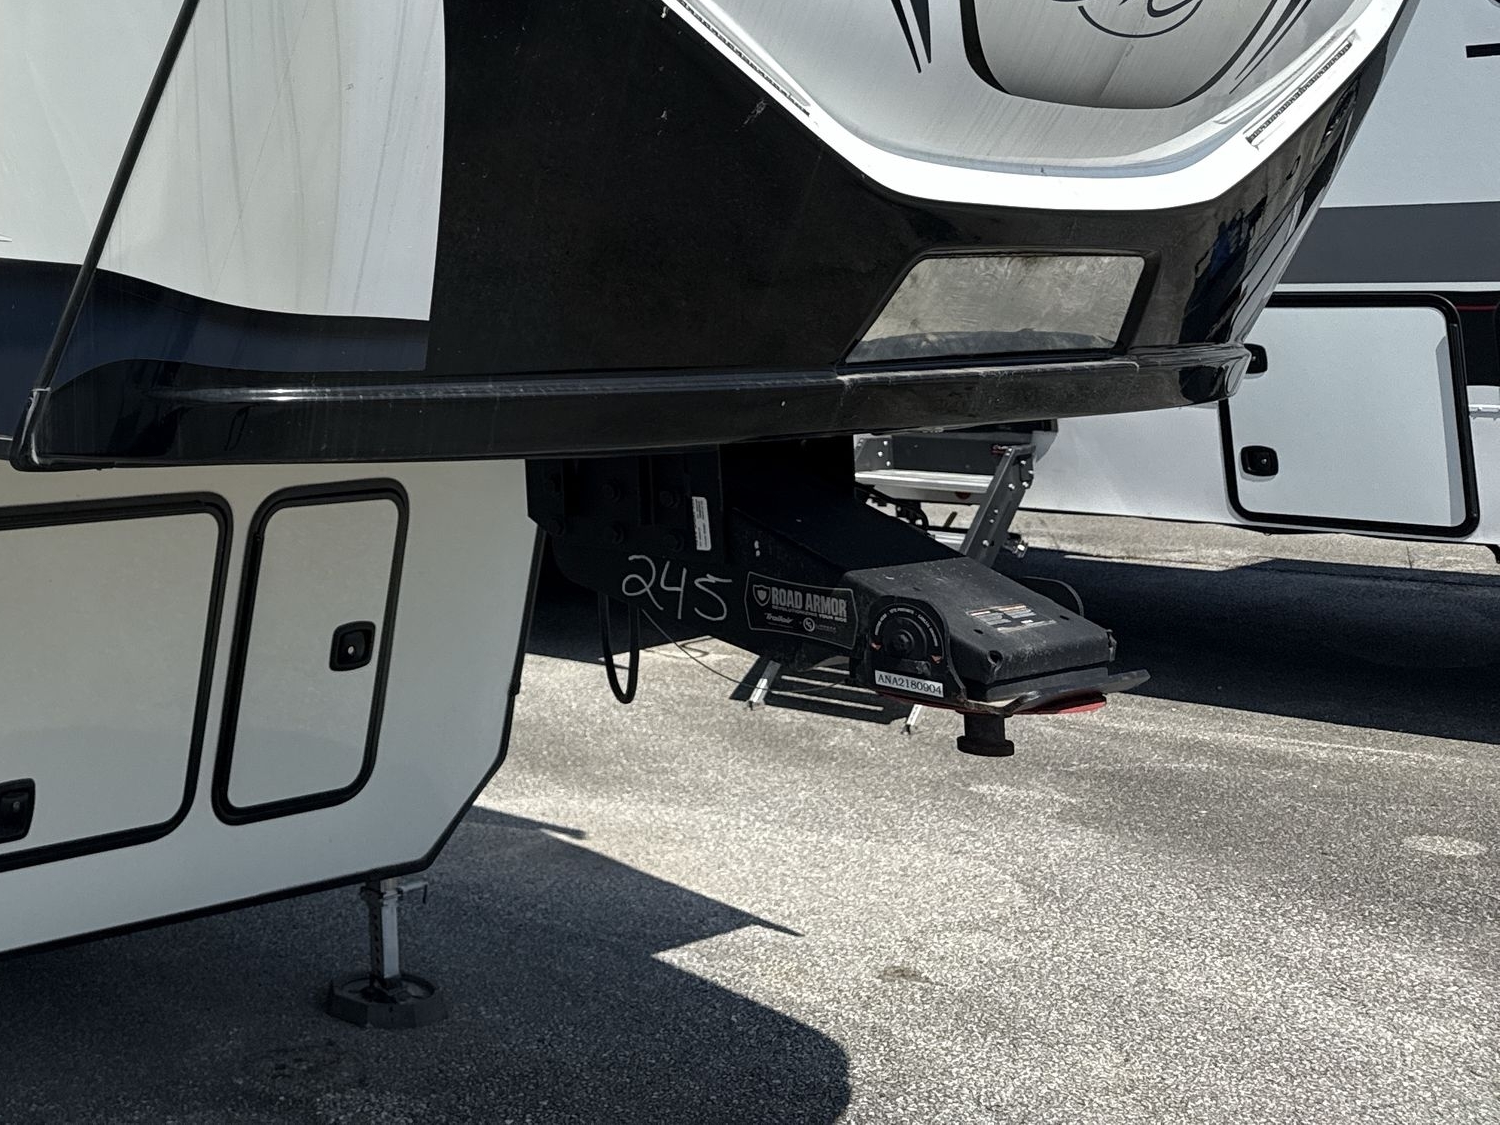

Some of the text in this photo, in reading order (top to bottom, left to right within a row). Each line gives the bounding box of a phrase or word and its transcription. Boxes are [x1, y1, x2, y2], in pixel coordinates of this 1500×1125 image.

[621, 554, 733, 621] 245
[771, 587, 848, 618] ROAD ARMOR
[878, 674, 942, 695] ANA2180904
